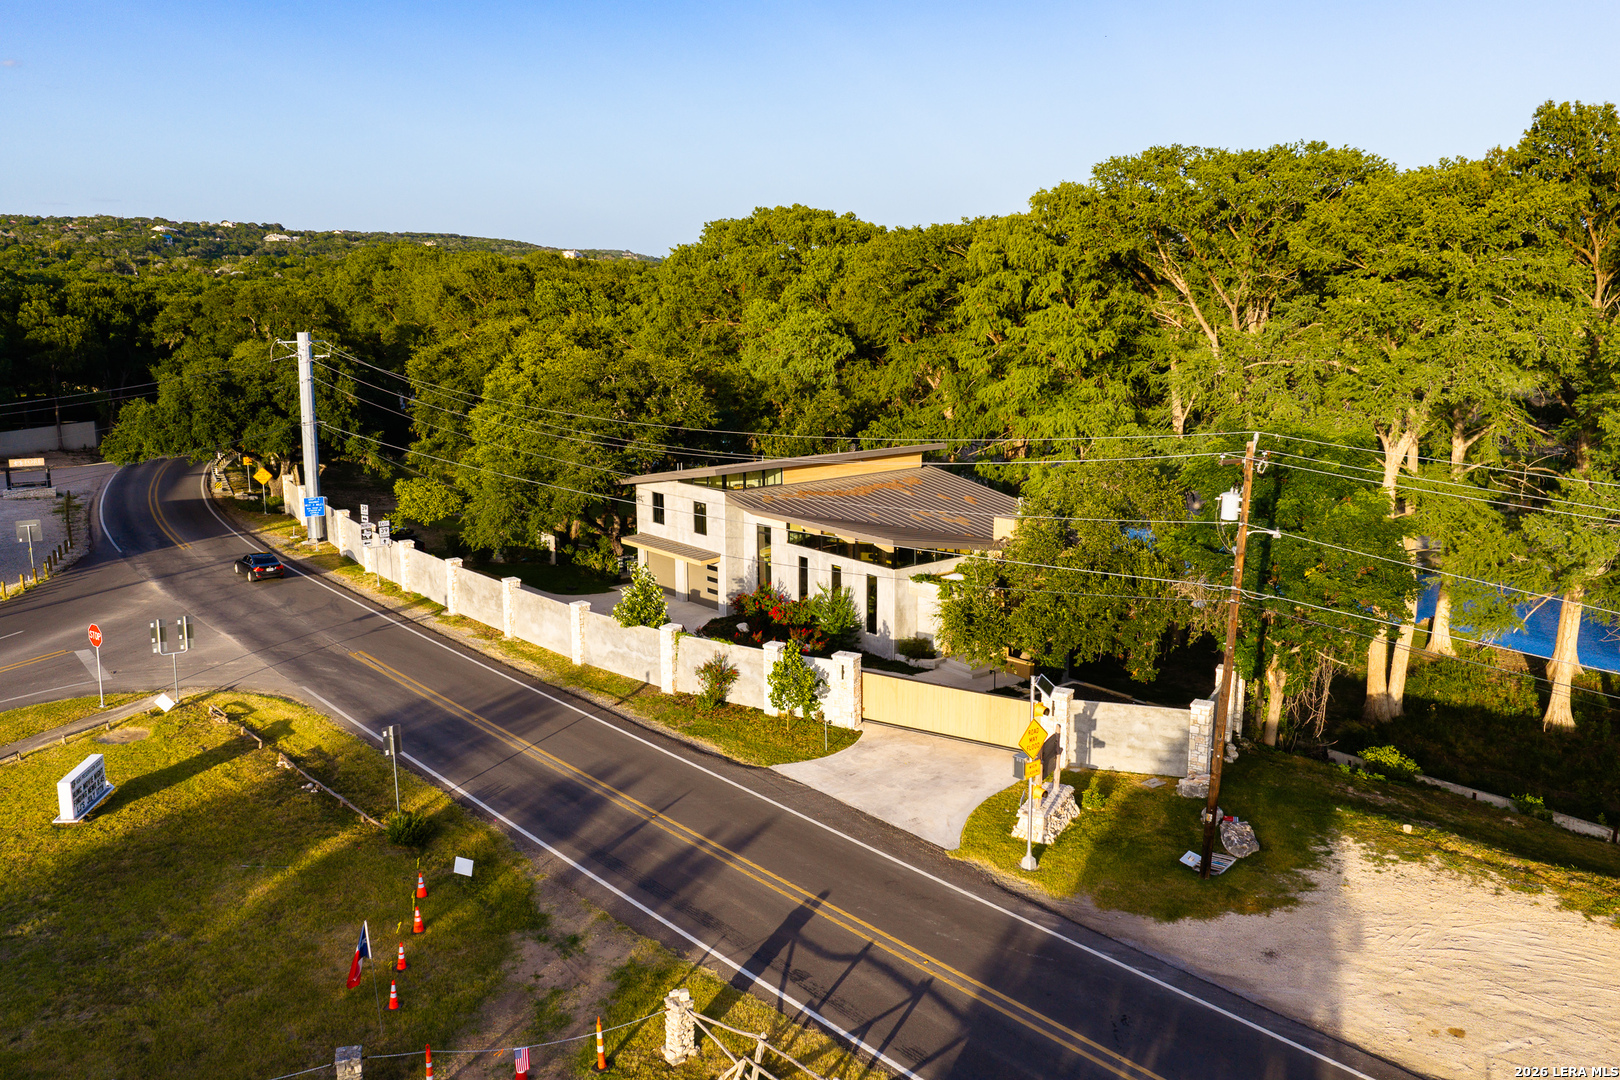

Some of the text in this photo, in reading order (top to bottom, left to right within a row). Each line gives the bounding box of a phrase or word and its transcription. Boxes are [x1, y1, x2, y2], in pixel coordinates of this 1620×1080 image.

[90, 630, 101, 640] STOP
[1028, 727, 1039, 735] ROAD
[1026, 742, 1040, 751] FLOOD
